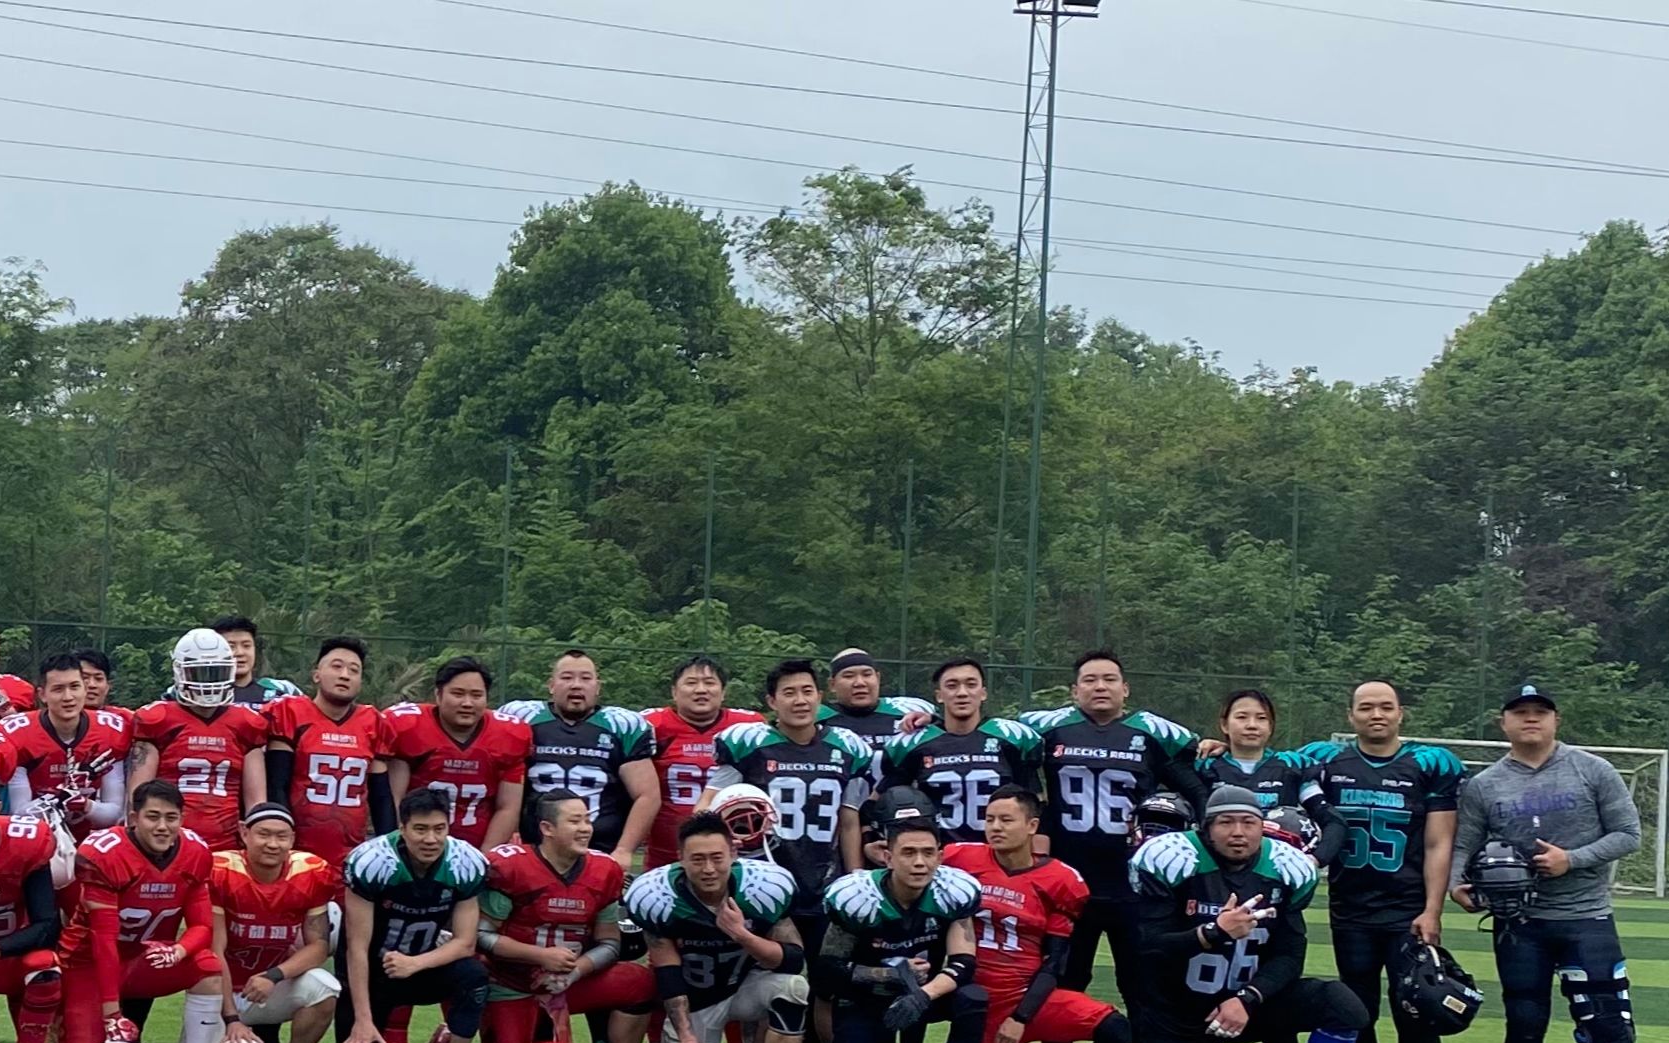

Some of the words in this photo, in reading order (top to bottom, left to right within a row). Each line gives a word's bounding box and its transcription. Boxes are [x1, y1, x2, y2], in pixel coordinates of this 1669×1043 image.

[934, 754, 970, 764] BECK'S
[1064, 747, 1107, 757] BECK'S
[178, 757, 231, 797] 21
[306, 754, 368, 807] 52
[768, 776, 843, 842] 83
[926, 769, 1001, 831] 36
[1058, 765, 1138, 835] 96
[1334, 805, 1413, 873] 55
[380, 919, 437, 956] 10
[975, 909, 1024, 951] 11
[682, 953, 748, 989] 87
